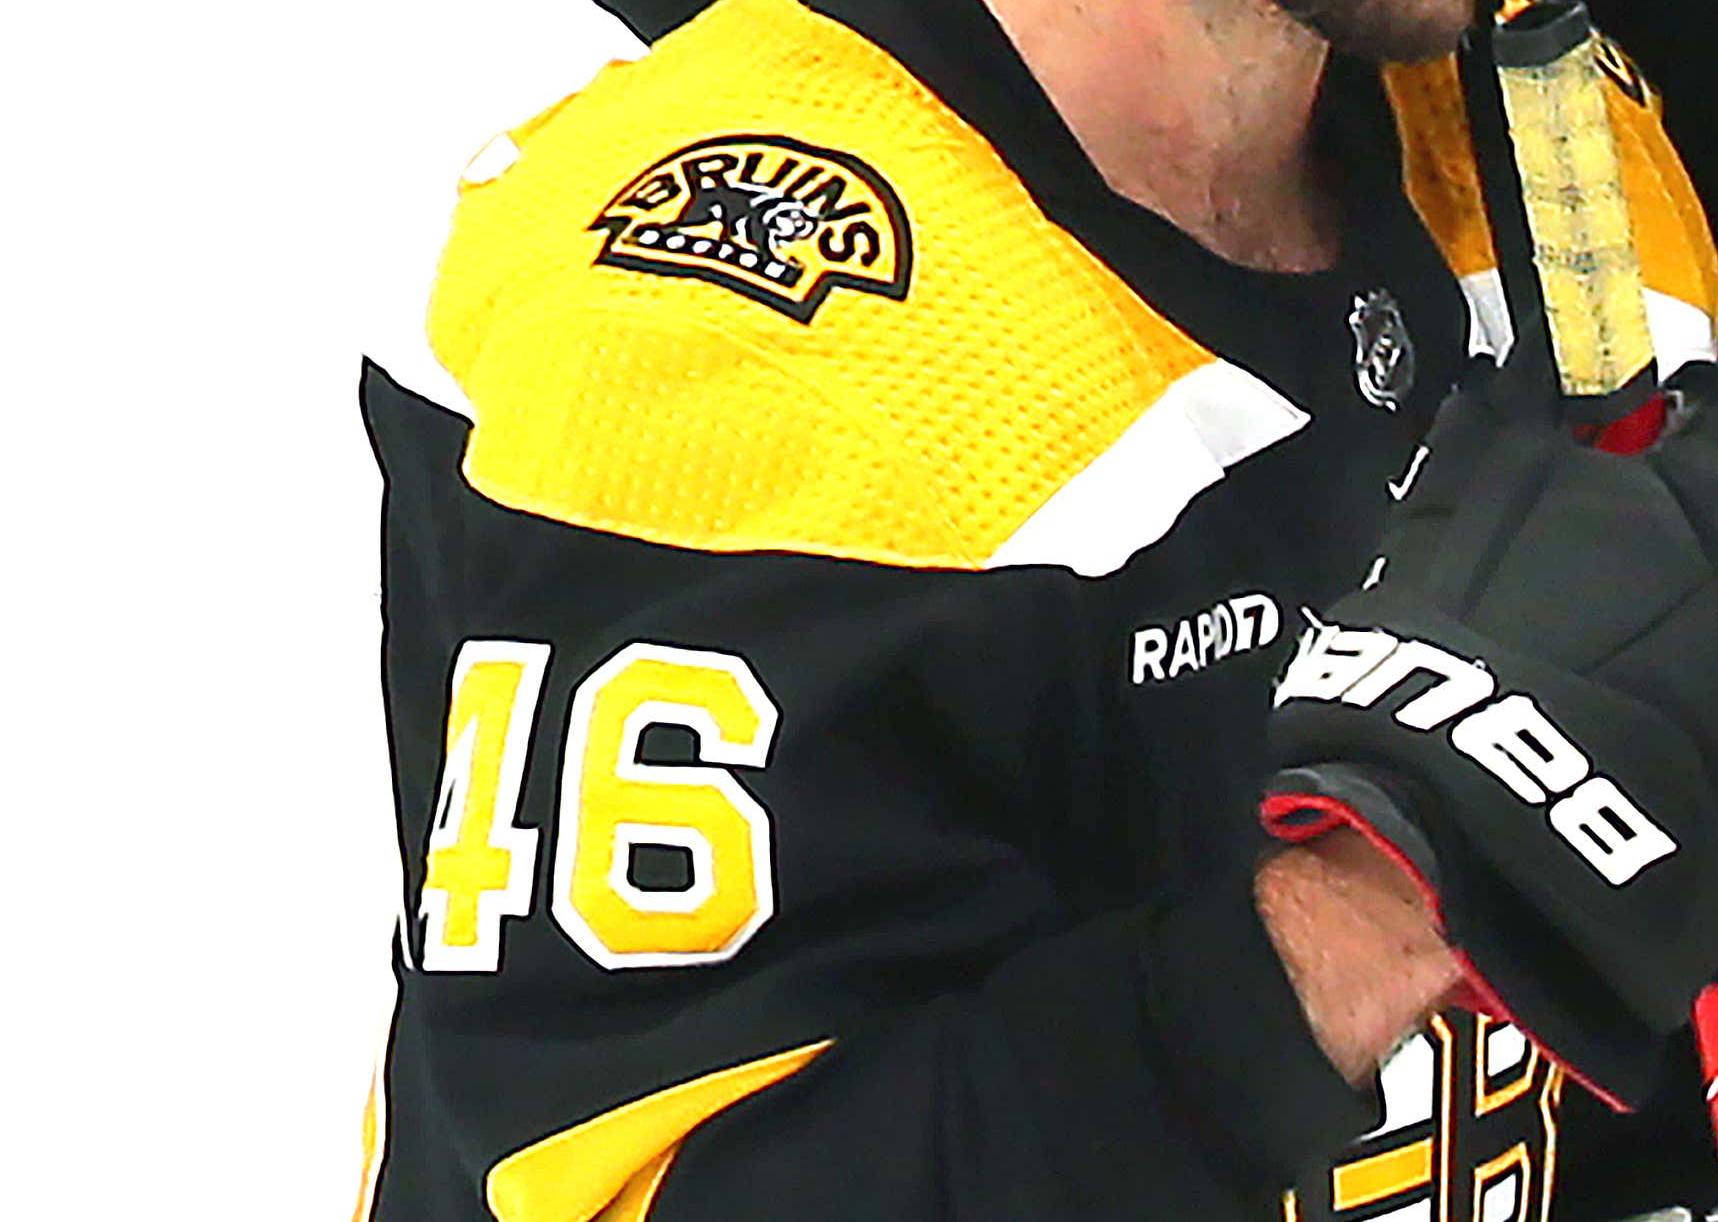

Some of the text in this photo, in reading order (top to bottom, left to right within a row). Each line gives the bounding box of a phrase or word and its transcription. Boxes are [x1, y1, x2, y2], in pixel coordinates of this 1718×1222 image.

[618, 151, 882, 268] BRUINS
[1132, 593, 1280, 684] RAPD7
[416, 639, 784, 973] 46
